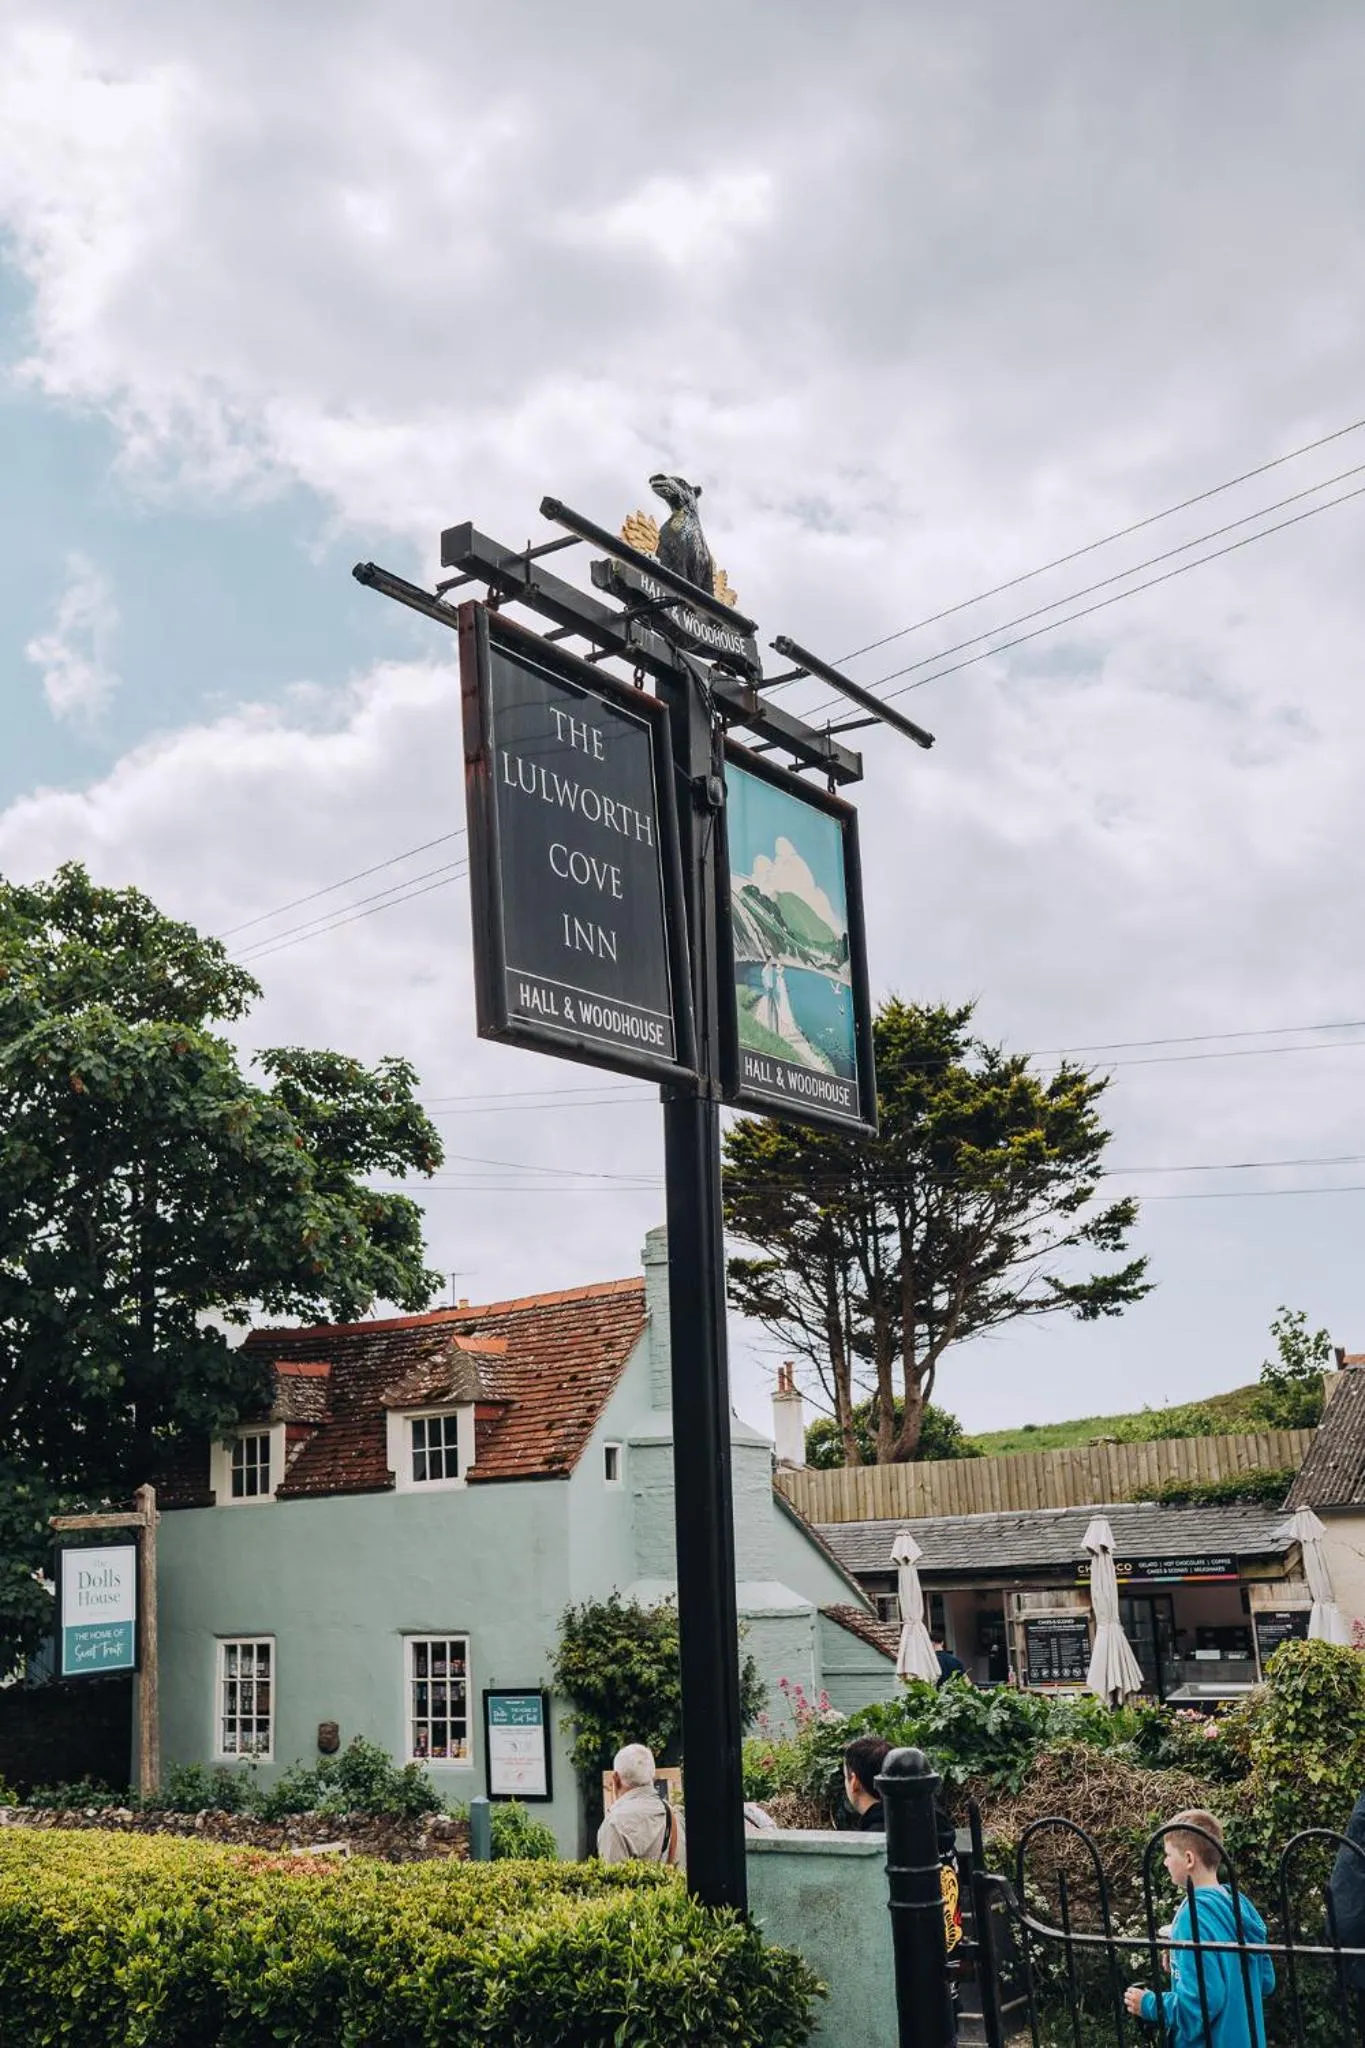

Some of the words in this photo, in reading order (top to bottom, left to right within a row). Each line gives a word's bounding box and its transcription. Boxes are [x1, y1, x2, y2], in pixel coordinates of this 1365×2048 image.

[640, 574, 667, 610] HAL
[671, 605, 680, 624] &
[683, 610, 746, 656] WOODHOUSE
[549, 706, 605, 762] THE
[502, 751, 654, 847] LULWORTH
[549, 842, 623, 900] COVE
[562, 913, 618, 963] INN
[519, 983, 559, 1017] HALL
[564, 996, 576, 1024] &
[578, 999, 665, 1046] WOODHOUSE
[744, 1056, 773, 1083] HALL
[776, 1066, 786, 1090] &
[787, 1070, 851, 1107] WOODHOUSE
[78, 1569, 121, 1589] Dolls
[1175, 1559, 1206, 1567] CHOCOLATE
[78, 1591, 121, 1607] House
[75, 1631, 90, 1641] THE
[90, 1629, 113, 1640] HOME
[113, 1628, 125, 1638] OF
